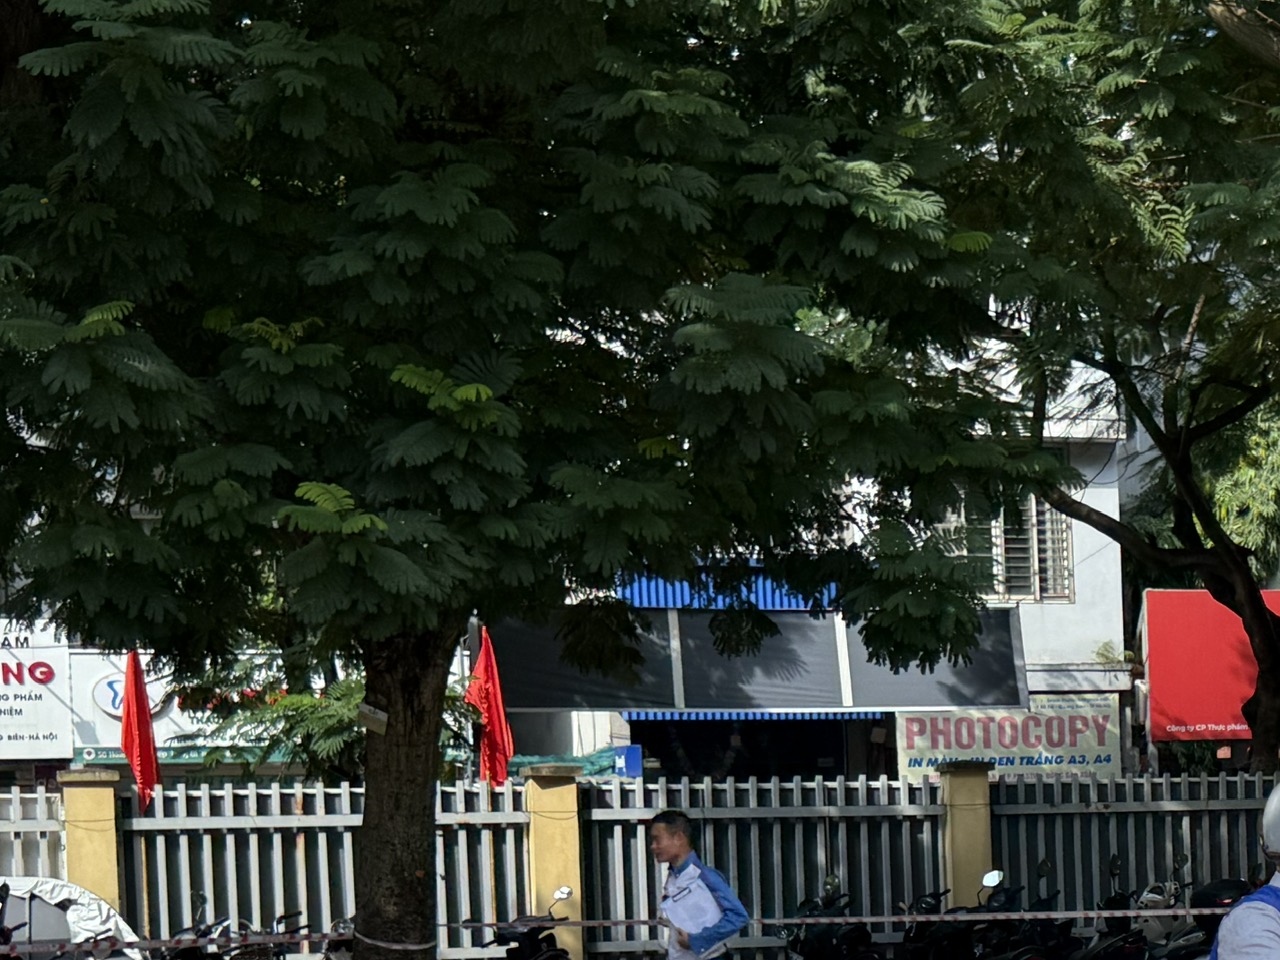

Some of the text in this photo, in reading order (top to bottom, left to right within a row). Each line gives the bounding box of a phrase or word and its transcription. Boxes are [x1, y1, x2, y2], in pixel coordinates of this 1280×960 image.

[905, 715, 1110, 749] PHOTOCOPY
[908, 758, 923, 767] IN
[1068, 755, 1089, 766] A3,
[1093, 754, 1112, 765] A4
